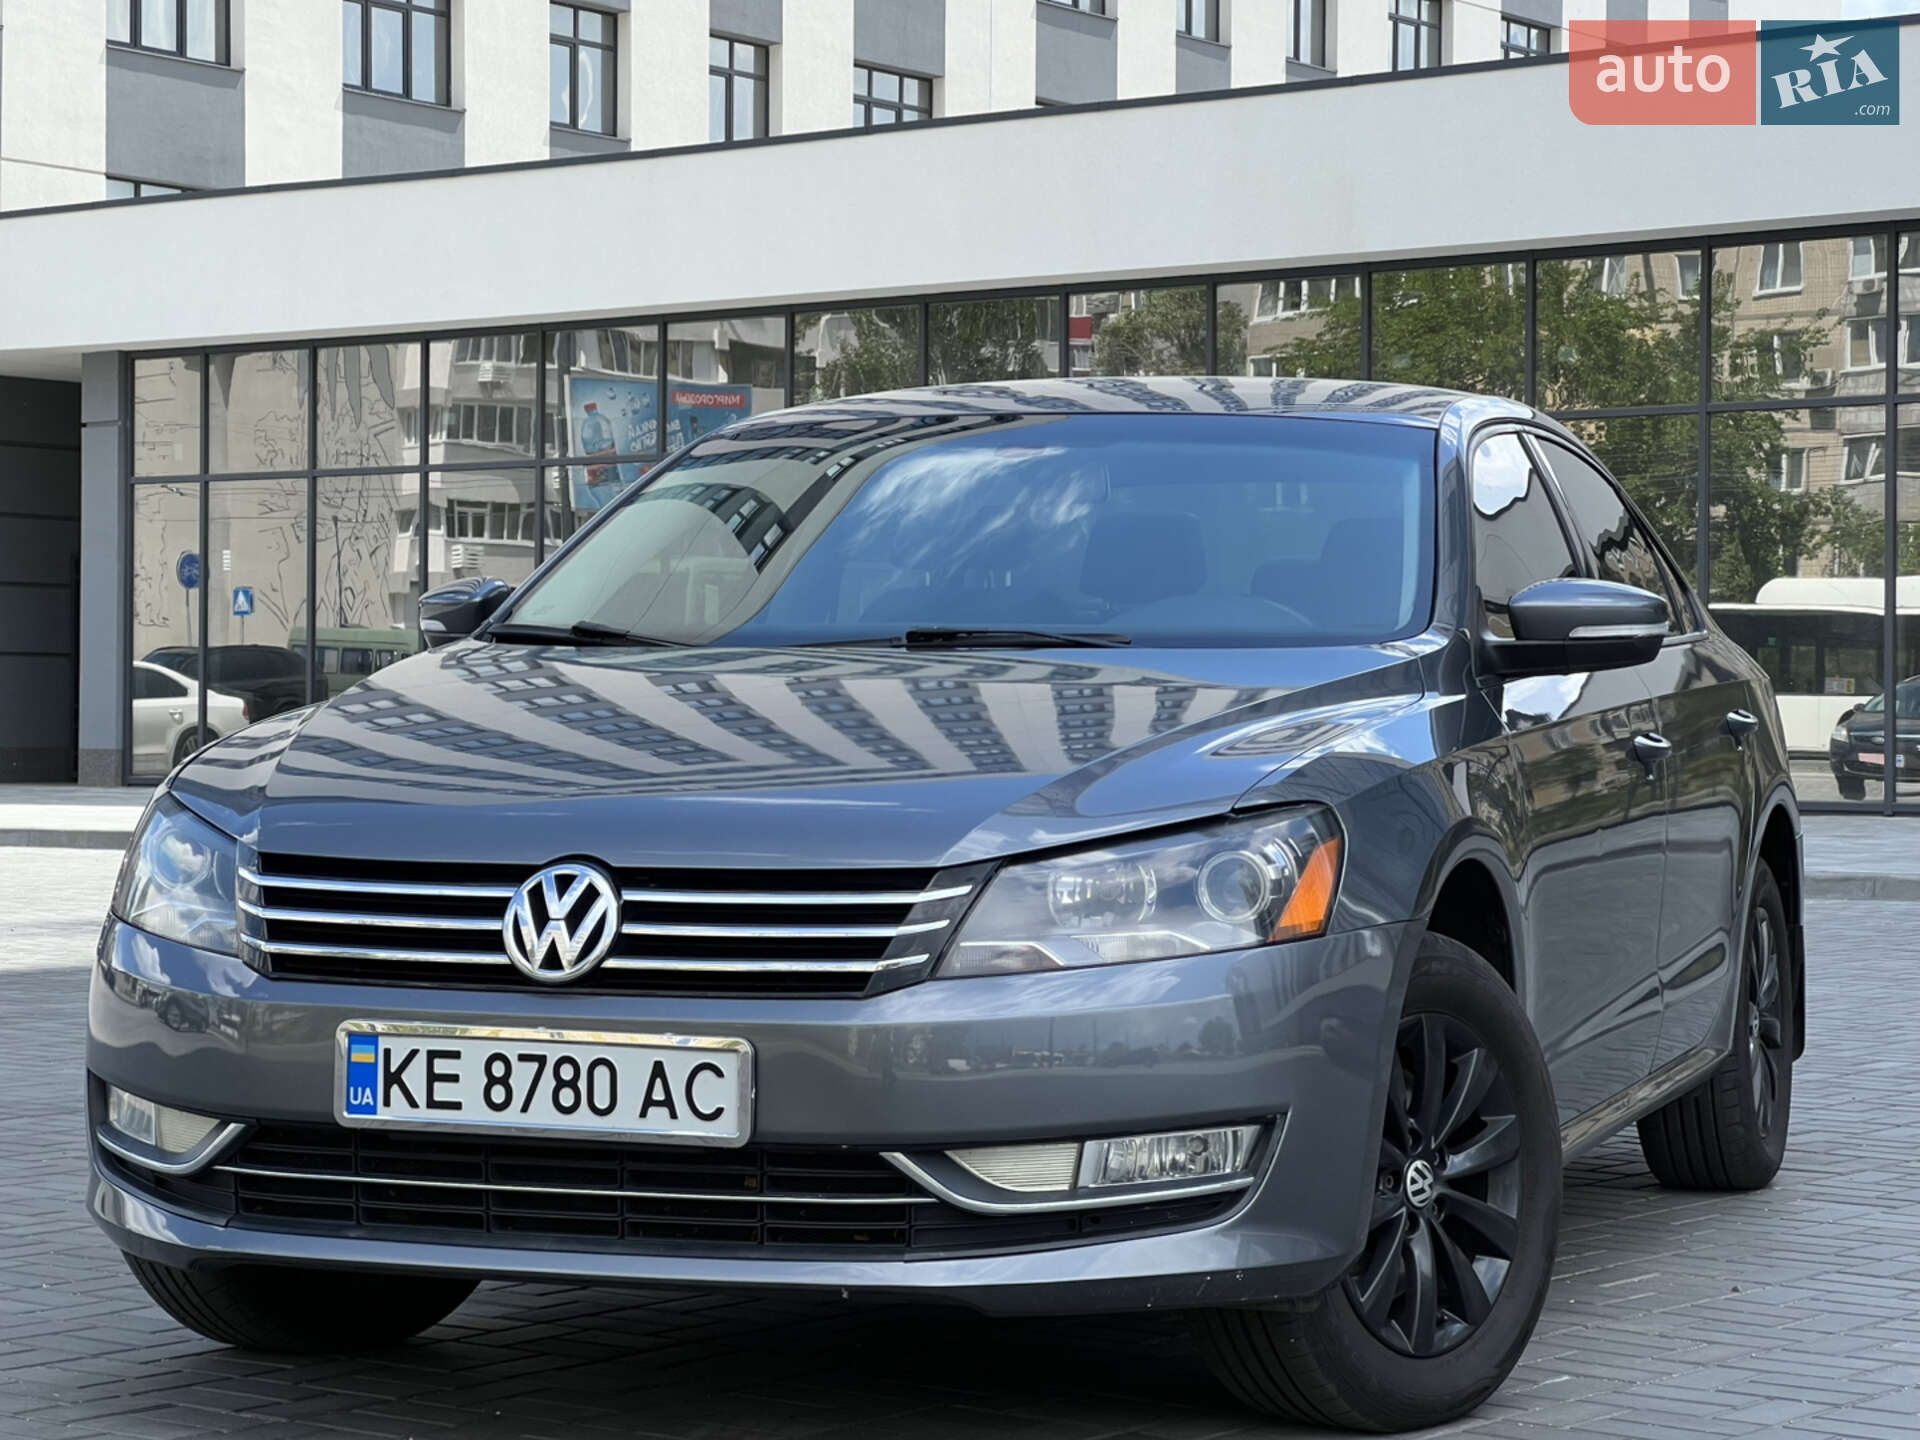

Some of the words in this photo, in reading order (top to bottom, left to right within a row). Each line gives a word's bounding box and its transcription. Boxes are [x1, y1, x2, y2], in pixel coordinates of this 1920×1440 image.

[349, 1085, 374, 1108] UA
[382, 1047, 463, 1111] KE
[483, 1051, 618, 1118] 8780
[638, 1059, 726, 1122] AC
